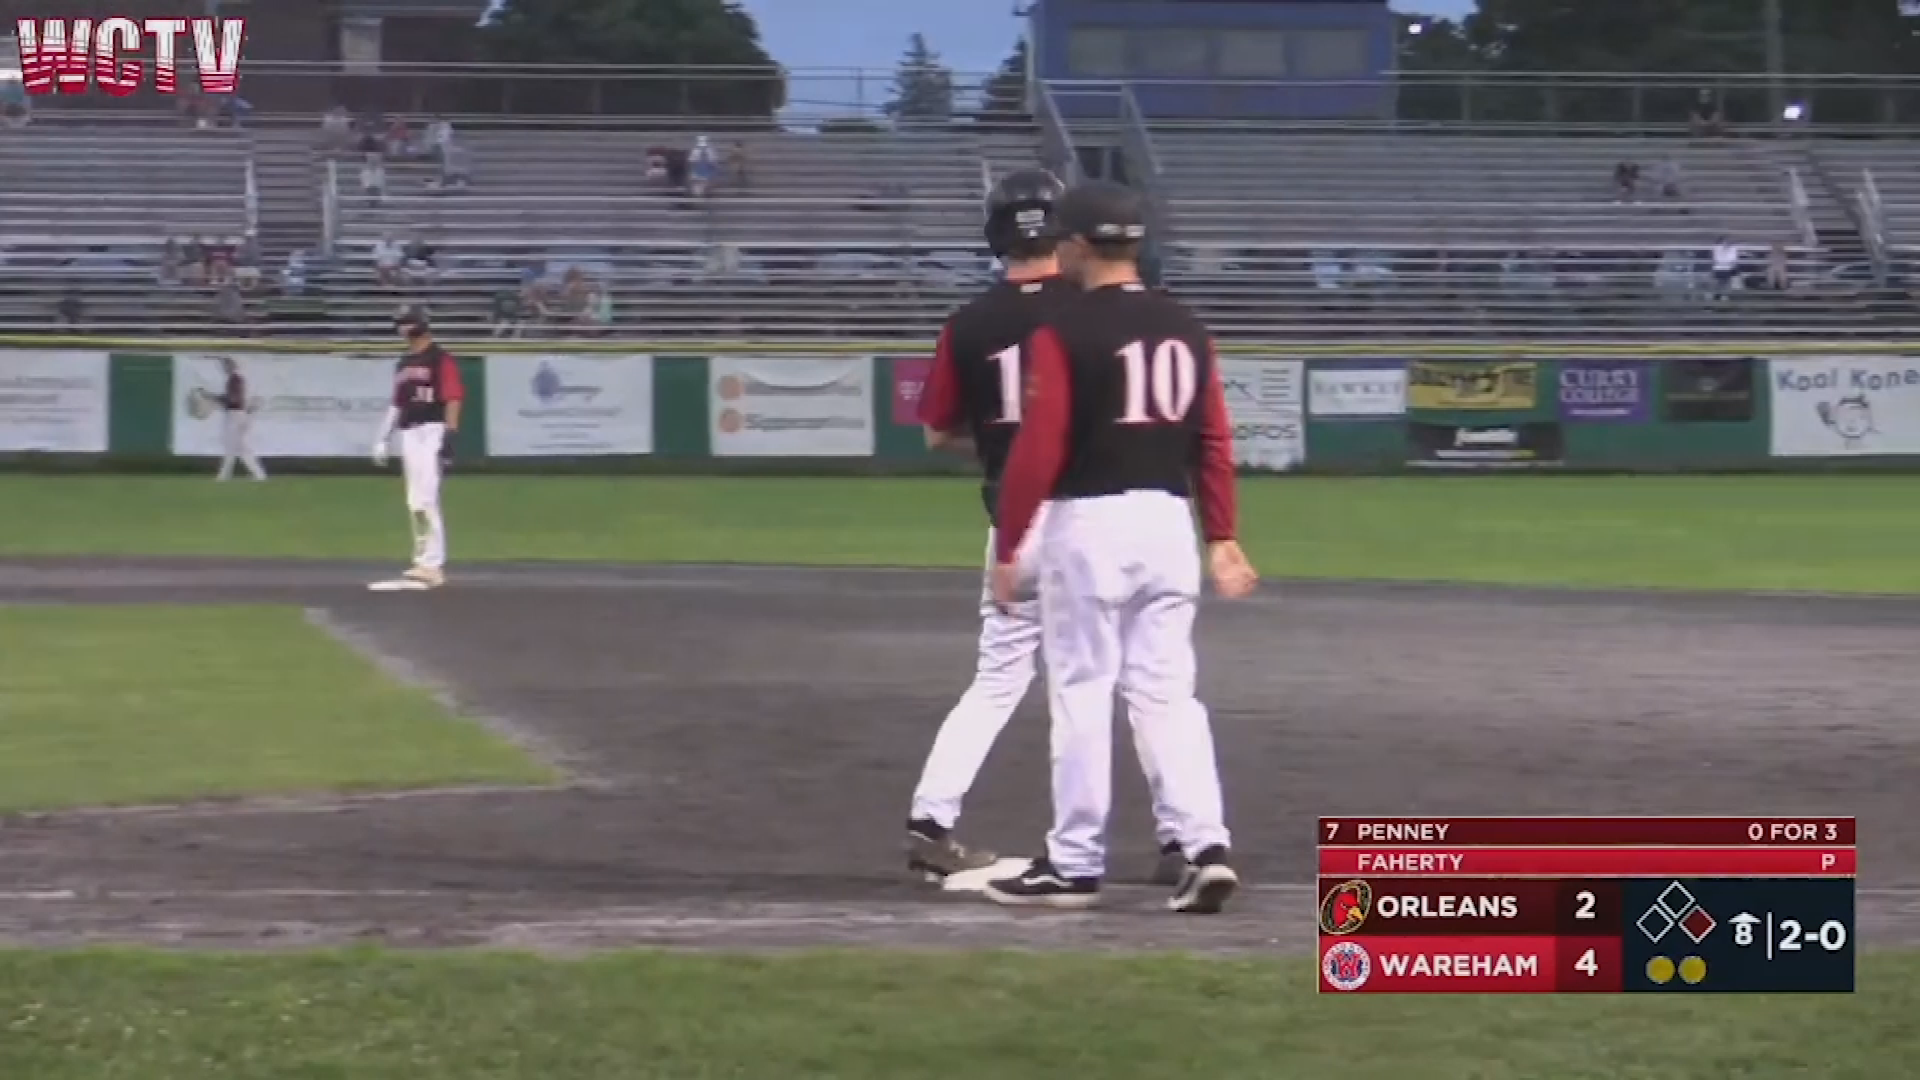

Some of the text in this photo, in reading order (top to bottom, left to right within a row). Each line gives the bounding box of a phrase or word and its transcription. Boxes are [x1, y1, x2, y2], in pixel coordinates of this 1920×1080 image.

[1114, 338, 1197, 424] 10
[1777, 366, 1920, 391] Kool Kone
